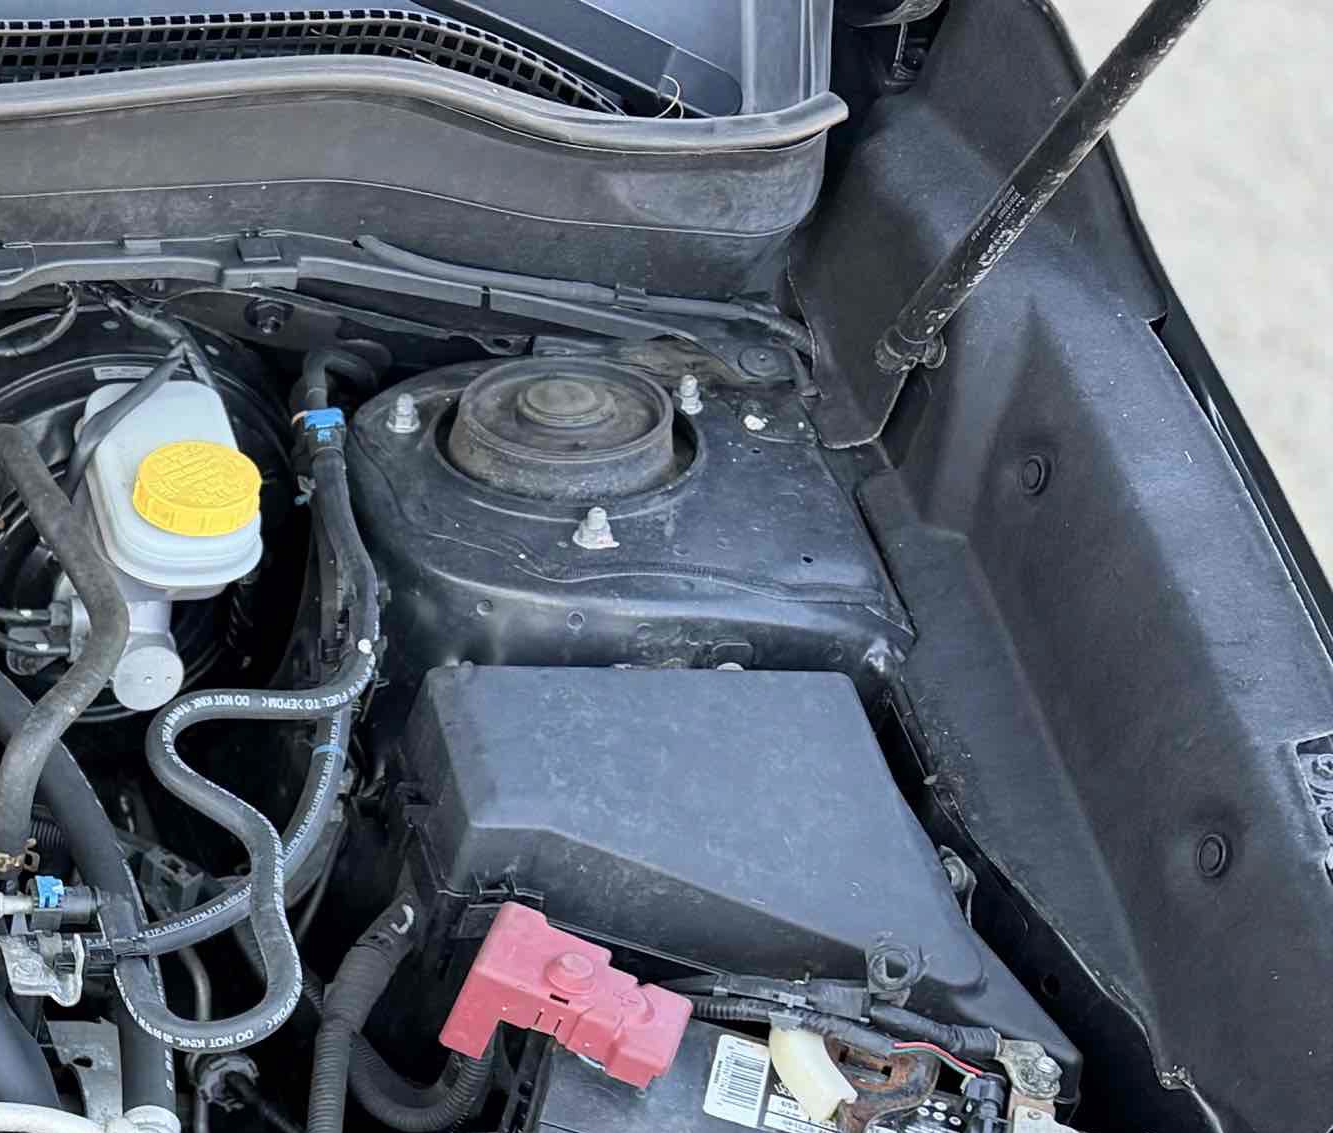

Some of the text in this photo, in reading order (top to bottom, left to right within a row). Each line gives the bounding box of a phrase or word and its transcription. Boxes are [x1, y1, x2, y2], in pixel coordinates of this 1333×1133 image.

[214, 694, 233, 706] NOT
[208, 1035, 233, 1048] NOT
[236, 1029, 254, 1043] DO
